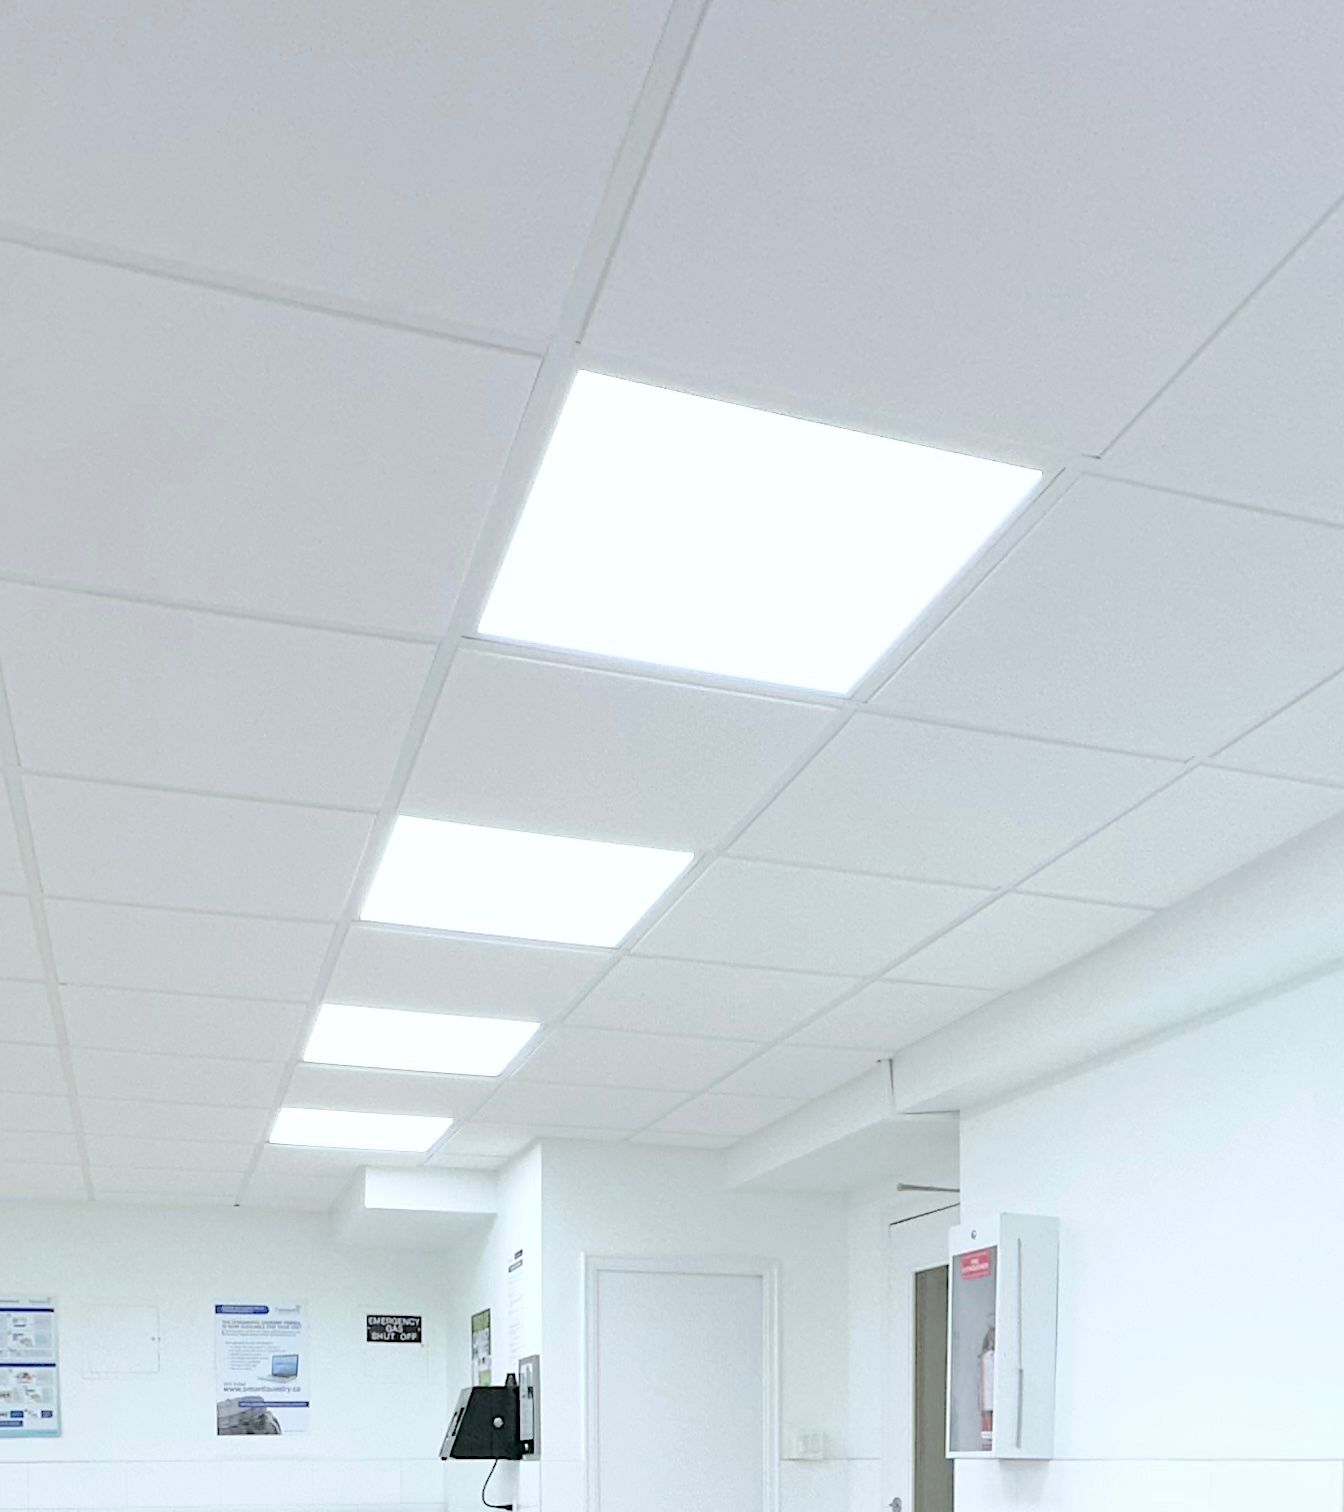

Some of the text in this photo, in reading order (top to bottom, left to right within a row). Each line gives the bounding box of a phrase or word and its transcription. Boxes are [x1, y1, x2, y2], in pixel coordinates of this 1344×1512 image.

[368, 1317, 420, 1327] EMERGENCY
[371, 1332, 417, 1342] SHUT OFF
